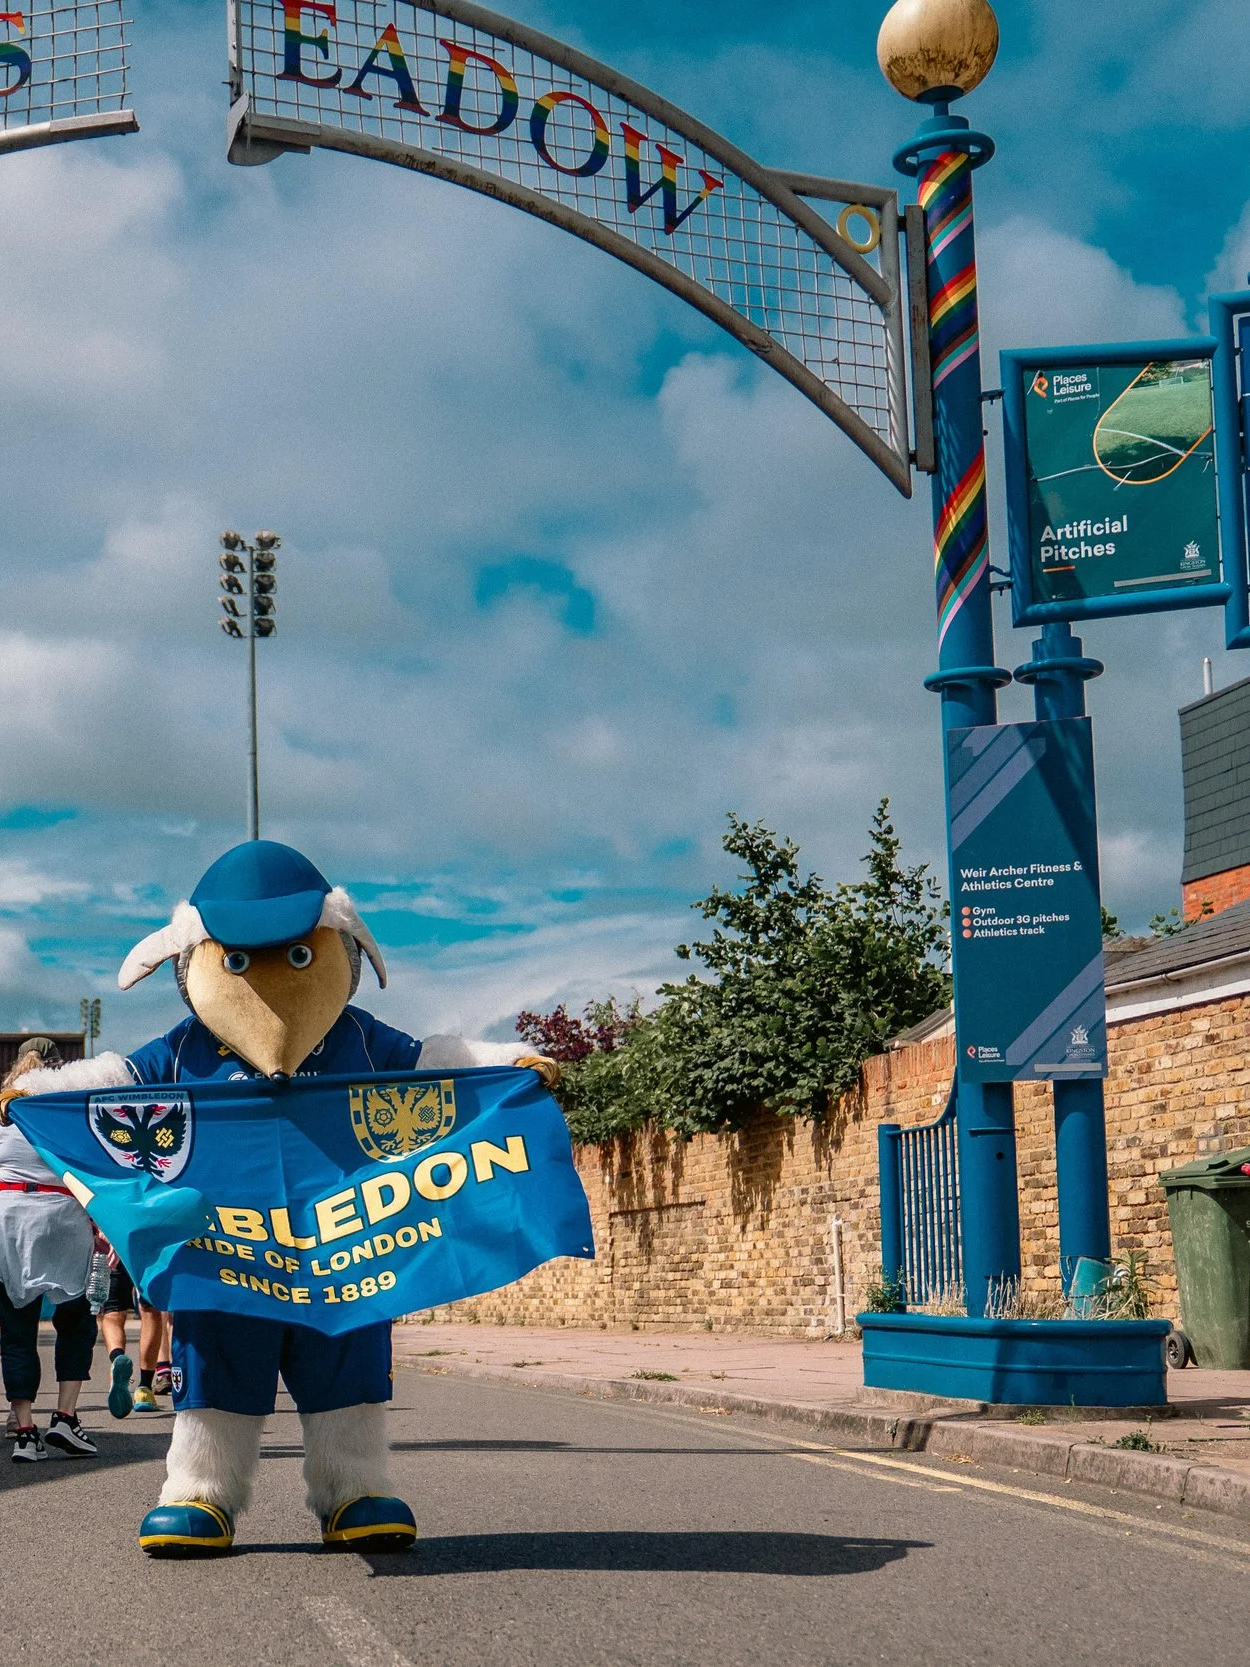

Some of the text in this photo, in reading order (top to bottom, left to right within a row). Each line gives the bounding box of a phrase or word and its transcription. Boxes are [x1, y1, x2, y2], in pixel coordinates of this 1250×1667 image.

[276, 0, 724, 235] EADOW
[1053, 373, 1088, 386] Places
[1053, 382, 1092, 396] Leisure
[1040, 514, 1128, 543] Artificial
[1040, 541, 1116, 563] Pitches
[960, 860, 1083, 879] Weir Archer Fitness &
[961, 877, 1054, 892] Athletics Centre
[972, 906, 996, 917] Gym
[972, 913, 1070, 927] Outdoor 3G pitches
[973, 925, 1046, 938] Athletics track
[95, 1092, 184, 1103] AFC WIMBLEDON
[207, 1135, 530, 1249] BLEDON
[264, 1249, 300, 1274] OF
[311, 1217, 443, 1277] LONDON
[219, 1268, 397, 1304] SINCE 1889
